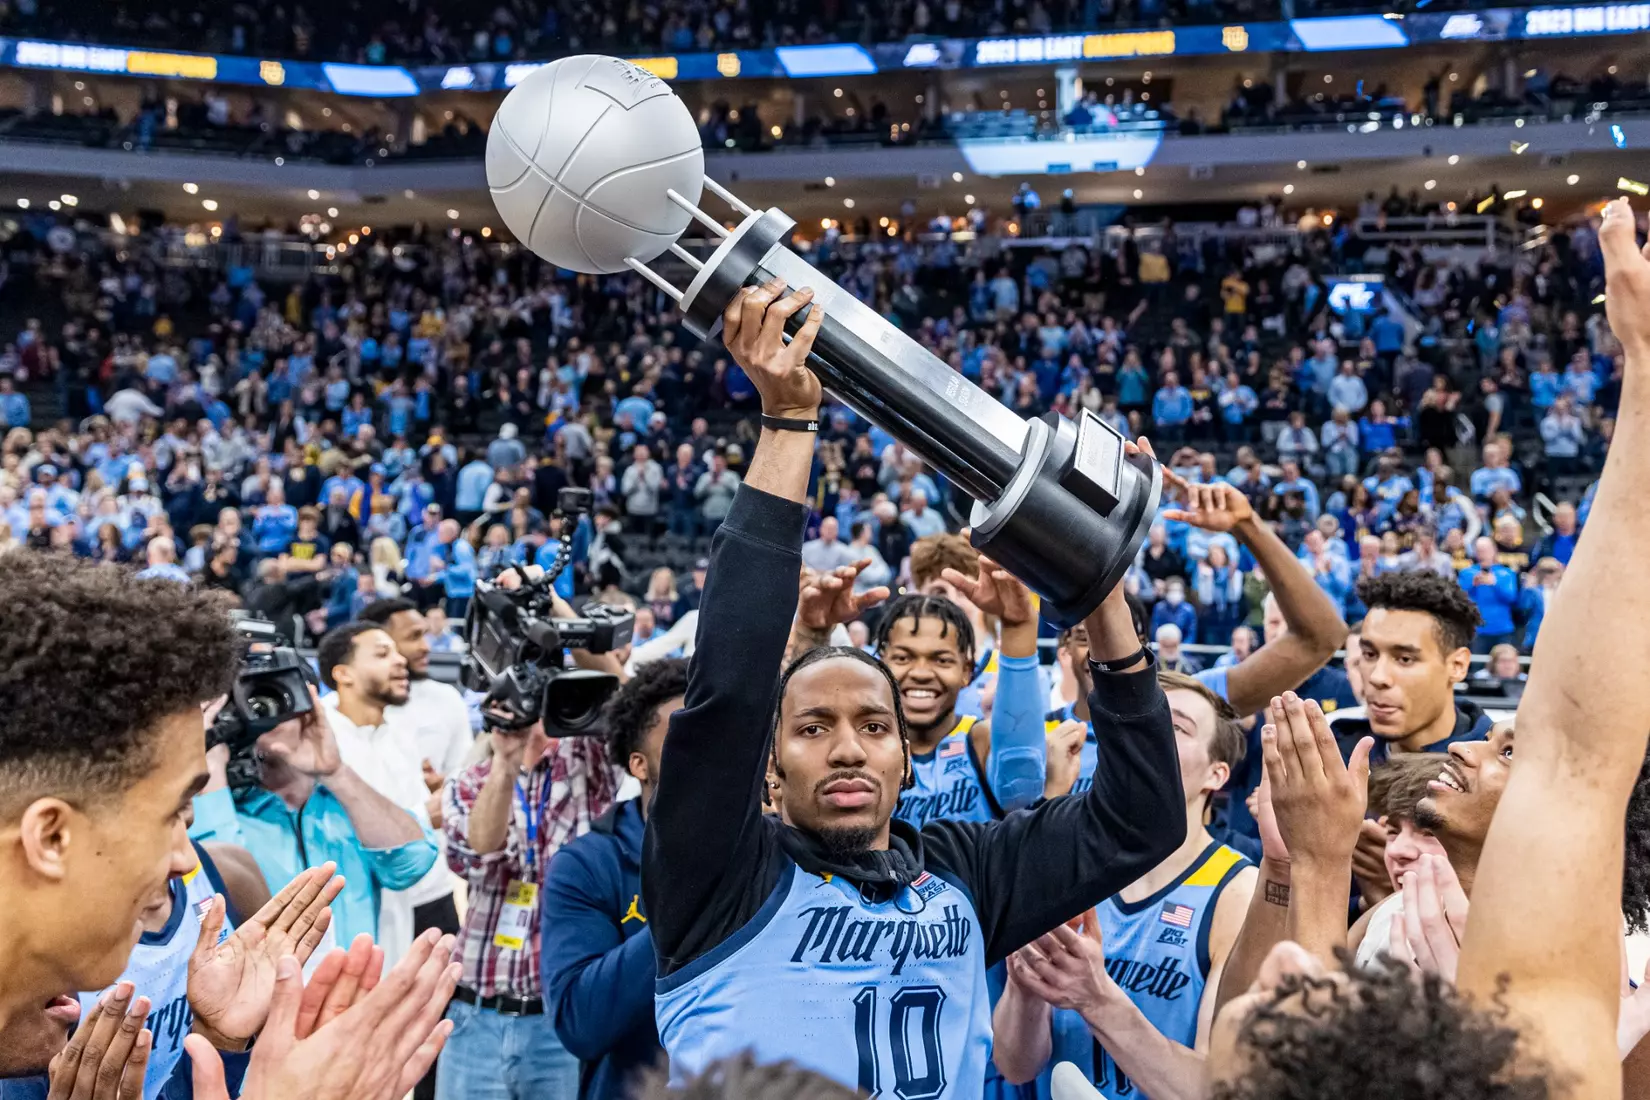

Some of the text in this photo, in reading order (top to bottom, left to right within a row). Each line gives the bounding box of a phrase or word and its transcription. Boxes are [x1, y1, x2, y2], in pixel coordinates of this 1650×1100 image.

[918, 880, 937, 893] BIG
[1162, 927, 1184, 938] BIG
[790, 904, 971, 976] Marquette
[1159, 934, 1188, 945] EAST
[852, 985, 948, 1100] 10
